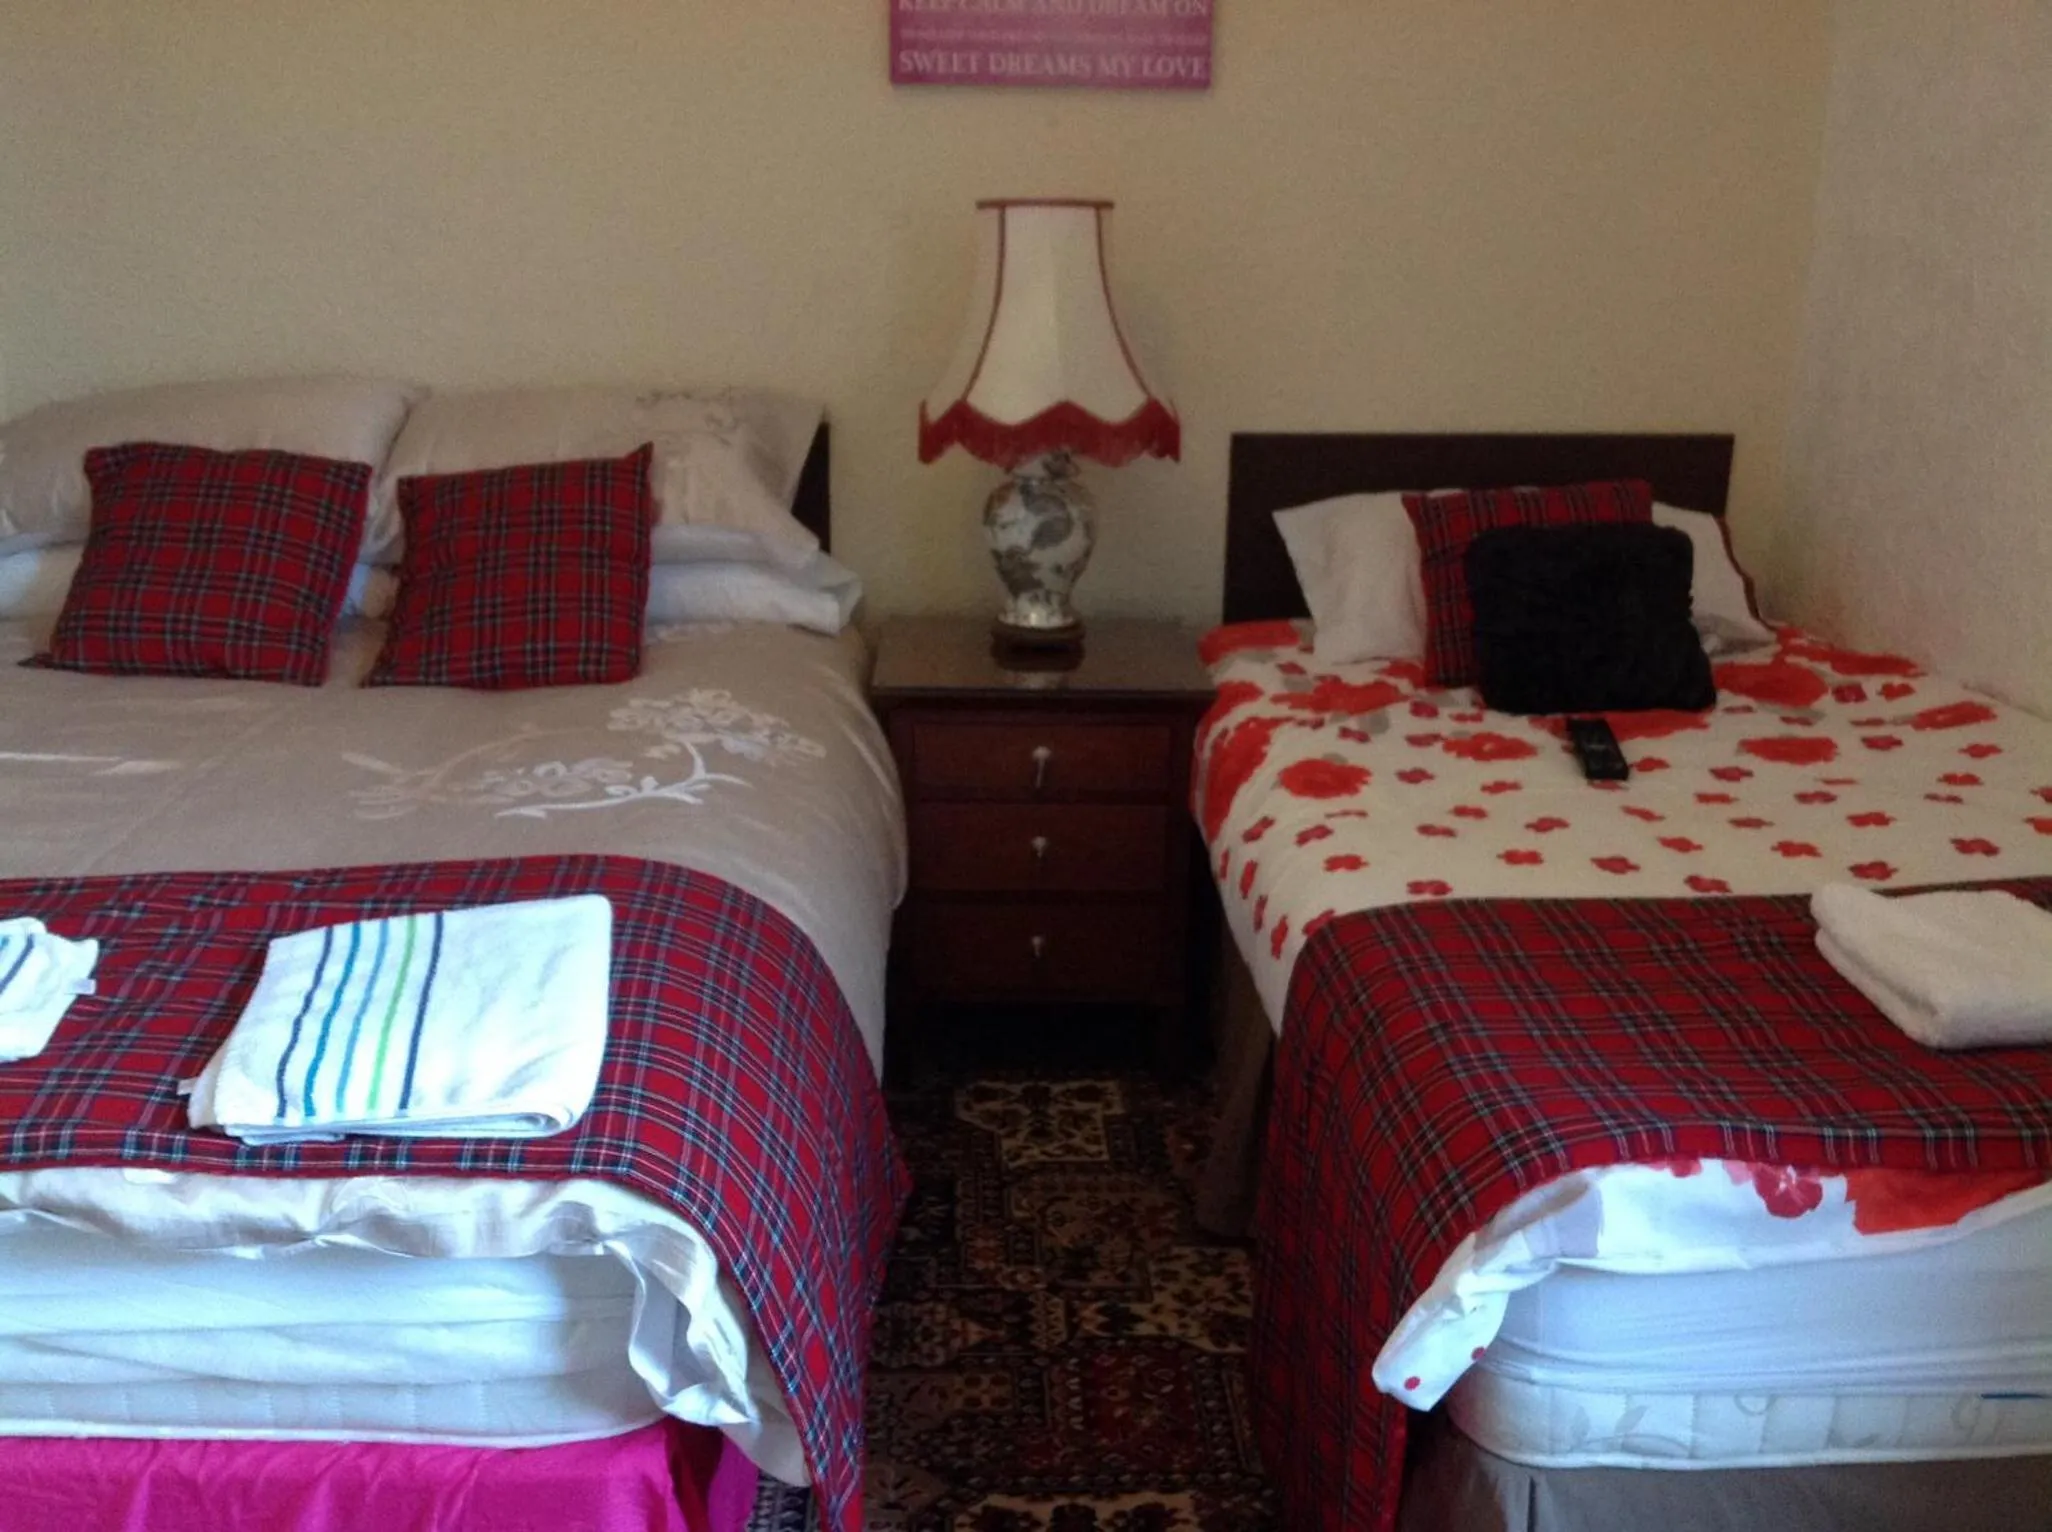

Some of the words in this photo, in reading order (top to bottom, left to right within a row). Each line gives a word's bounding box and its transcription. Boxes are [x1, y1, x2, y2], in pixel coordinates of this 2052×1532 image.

[898, 48, 983, 74] SWEET
[988, 52, 1092, 78] DREAMS
[1098, 53, 1138, 79] MY
[1142, 54, 1207, 80] LOVE
